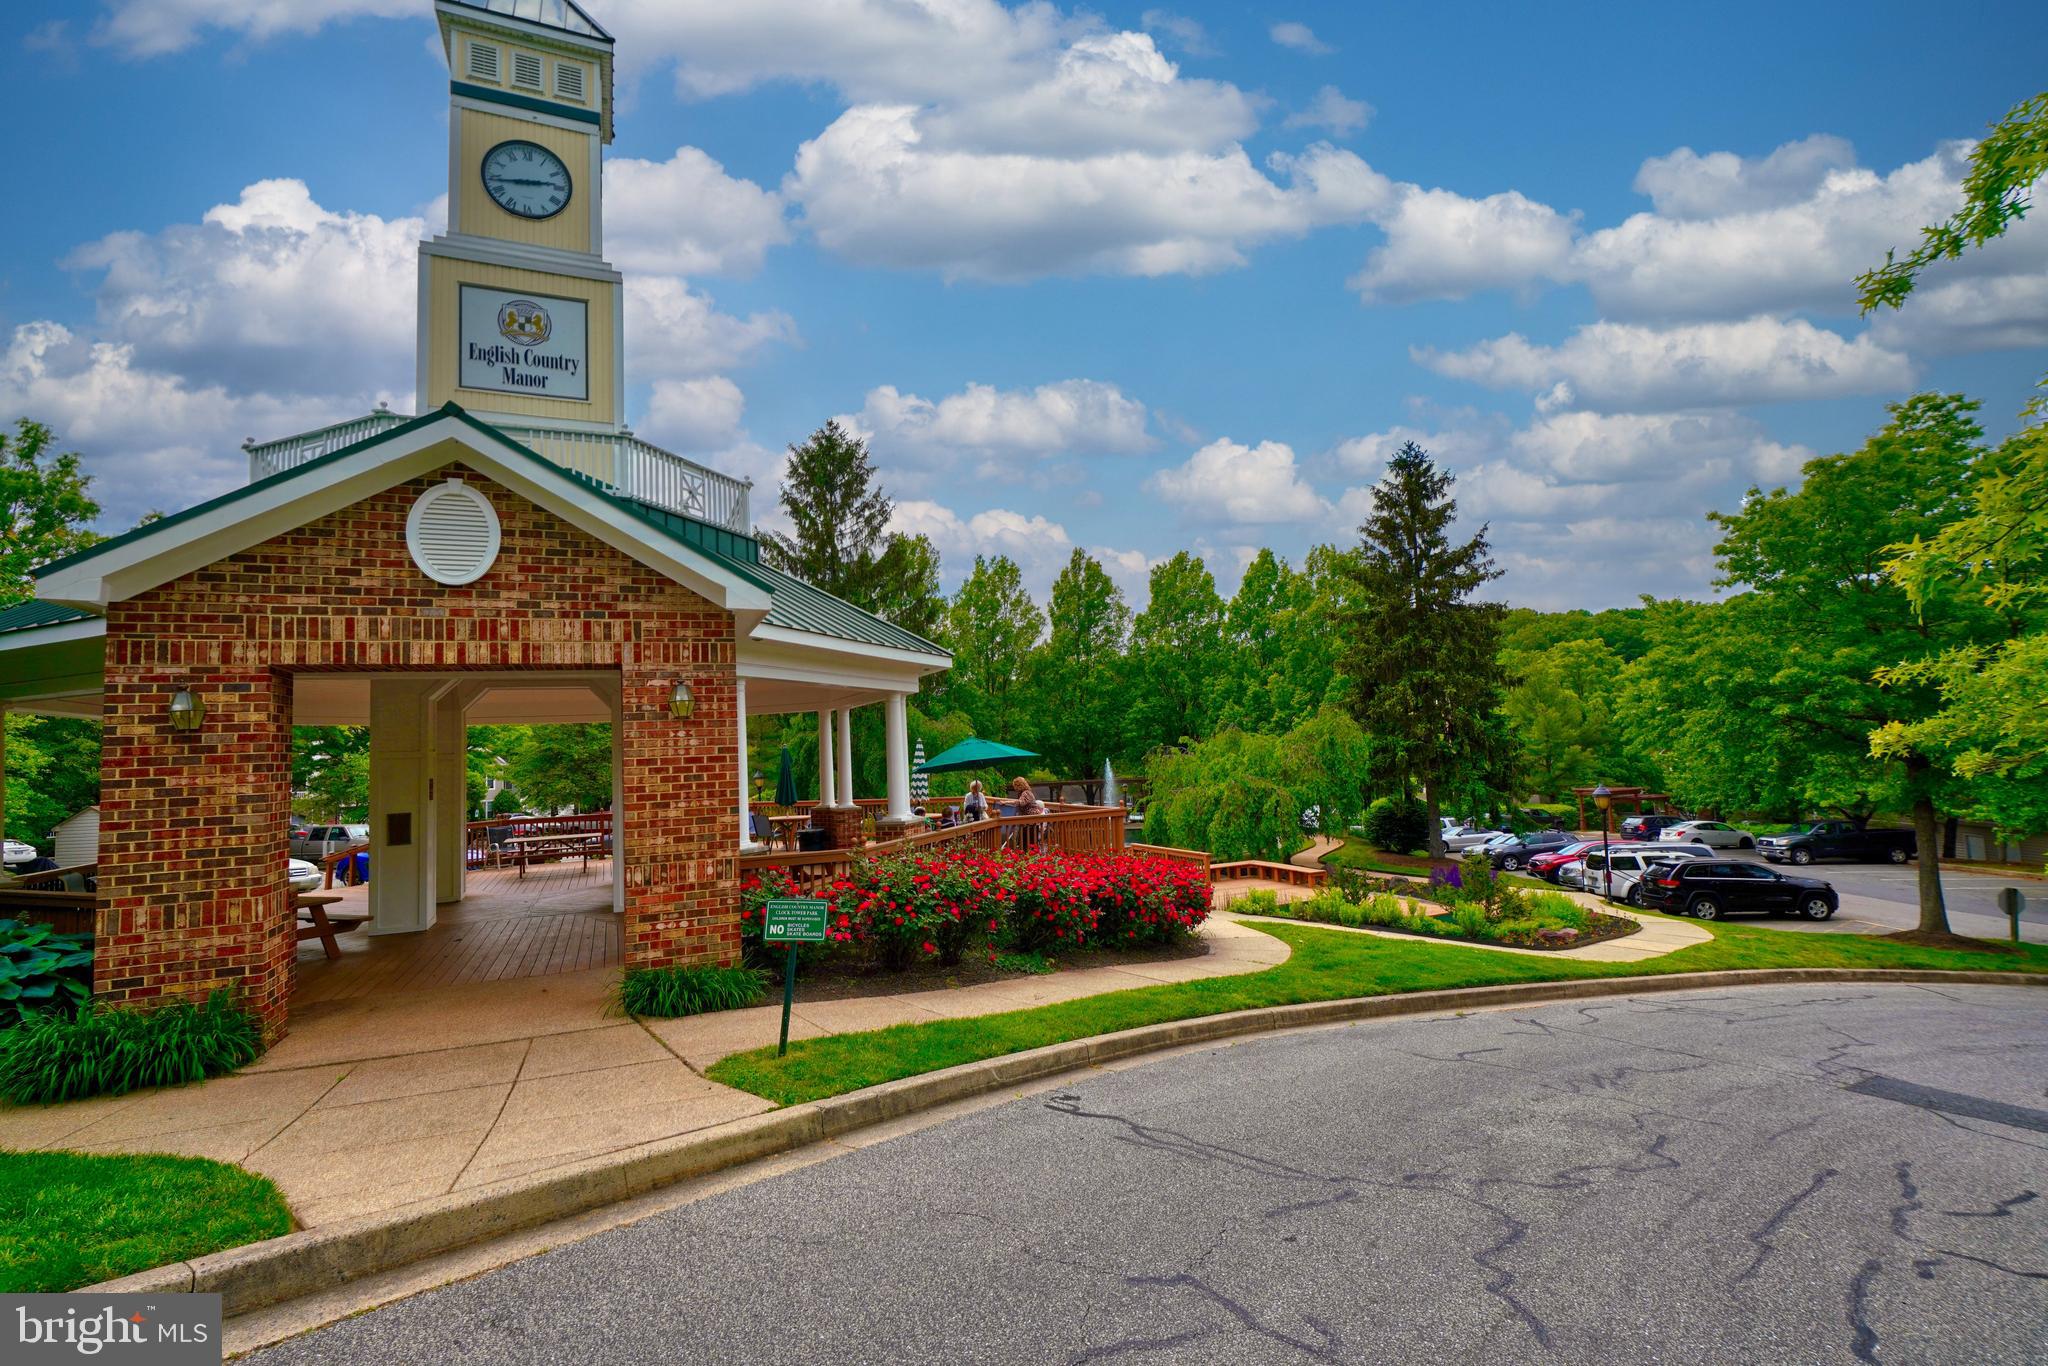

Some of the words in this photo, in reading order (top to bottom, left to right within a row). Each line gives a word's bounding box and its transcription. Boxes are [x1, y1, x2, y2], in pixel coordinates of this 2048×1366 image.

[469, 342, 520, 367] English
[524, 348, 580, 376] Country
[502, 366, 548, 388] Manor
[769, 925, 785, 935] NO
